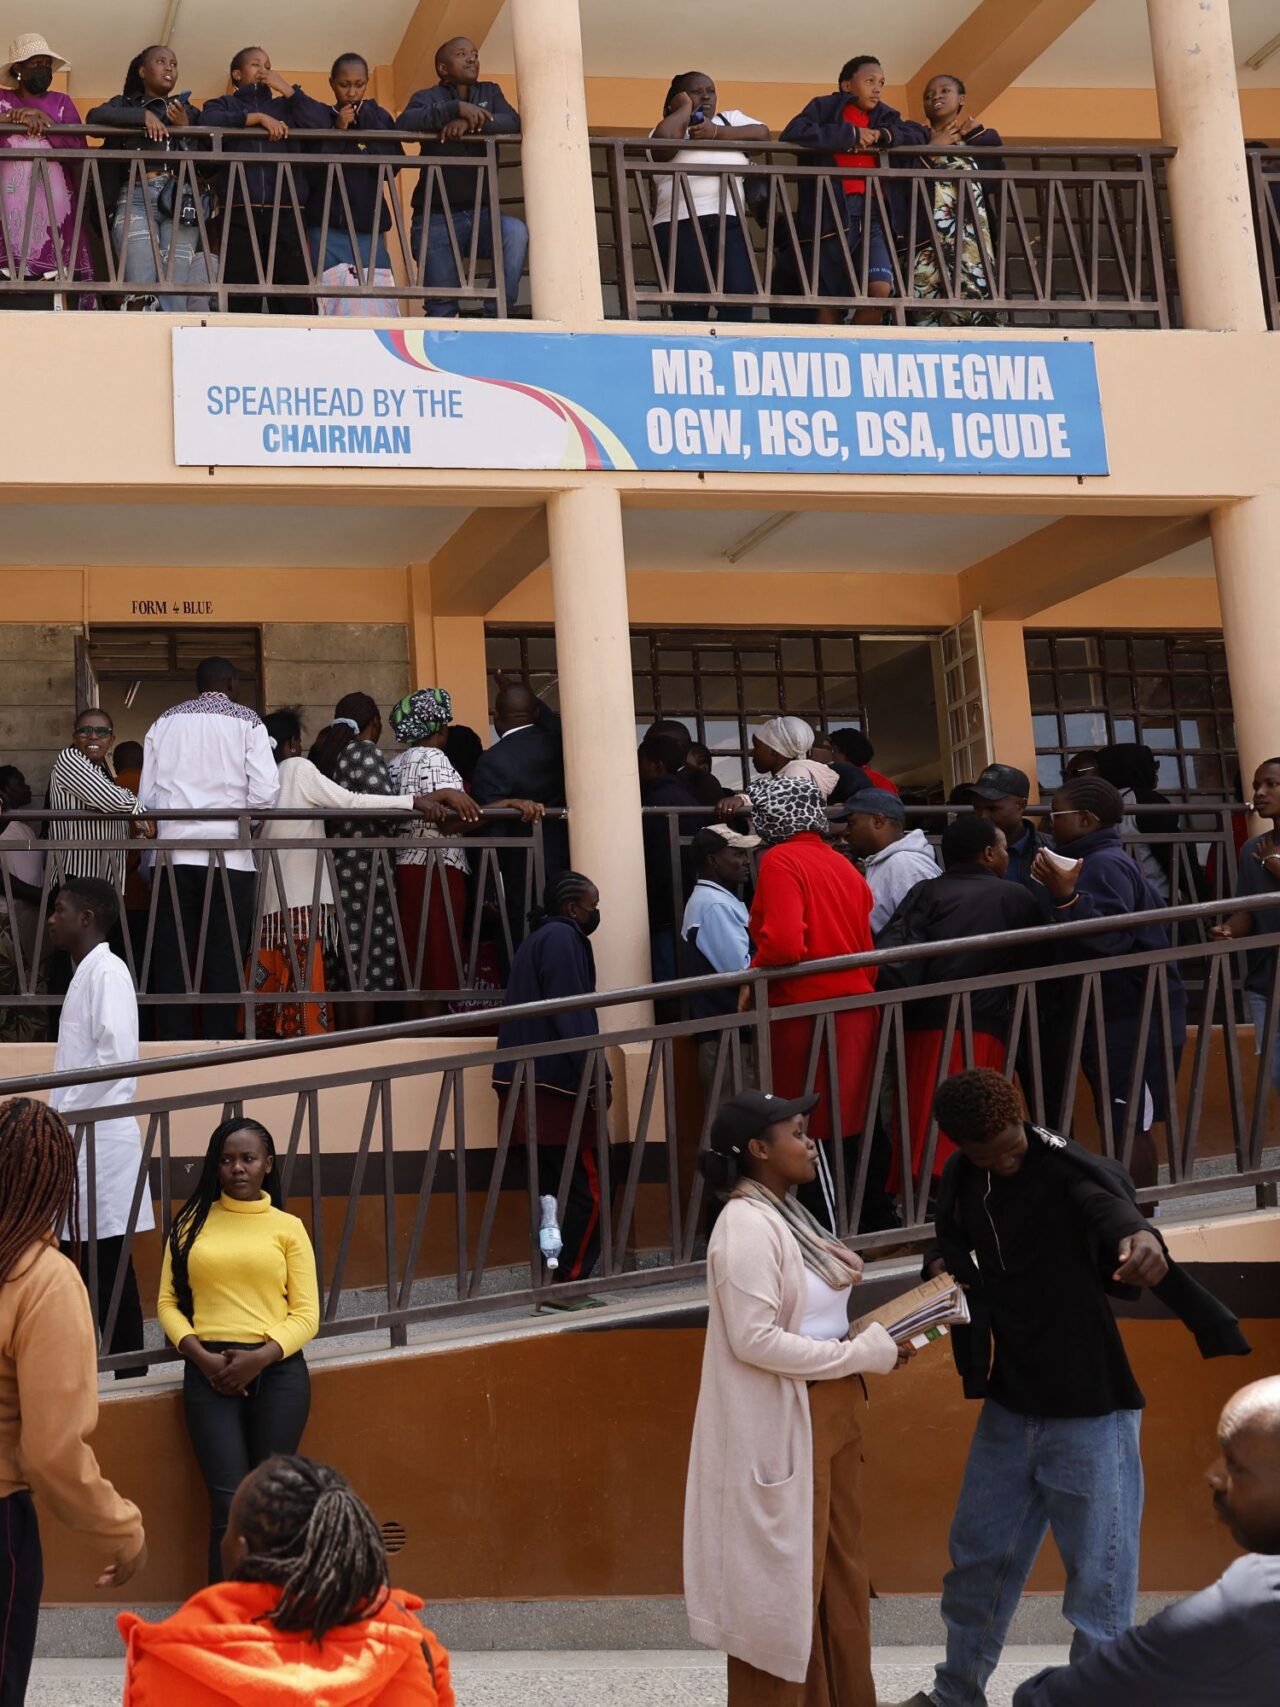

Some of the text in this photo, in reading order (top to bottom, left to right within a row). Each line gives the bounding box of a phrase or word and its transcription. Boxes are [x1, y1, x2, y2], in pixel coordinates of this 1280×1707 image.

[651, 349, 1054, 400] MR. DAVID MATEGWA
[206, 385, 463, 418] SPEARHEAD BY THE
[262, 423, 411, 454] CHAIRMAN
[646, 407, 1071, 463] OGW, HSC, DSA, ICUDE
[132, 600, 213, 615] FORM 4 BLUE
